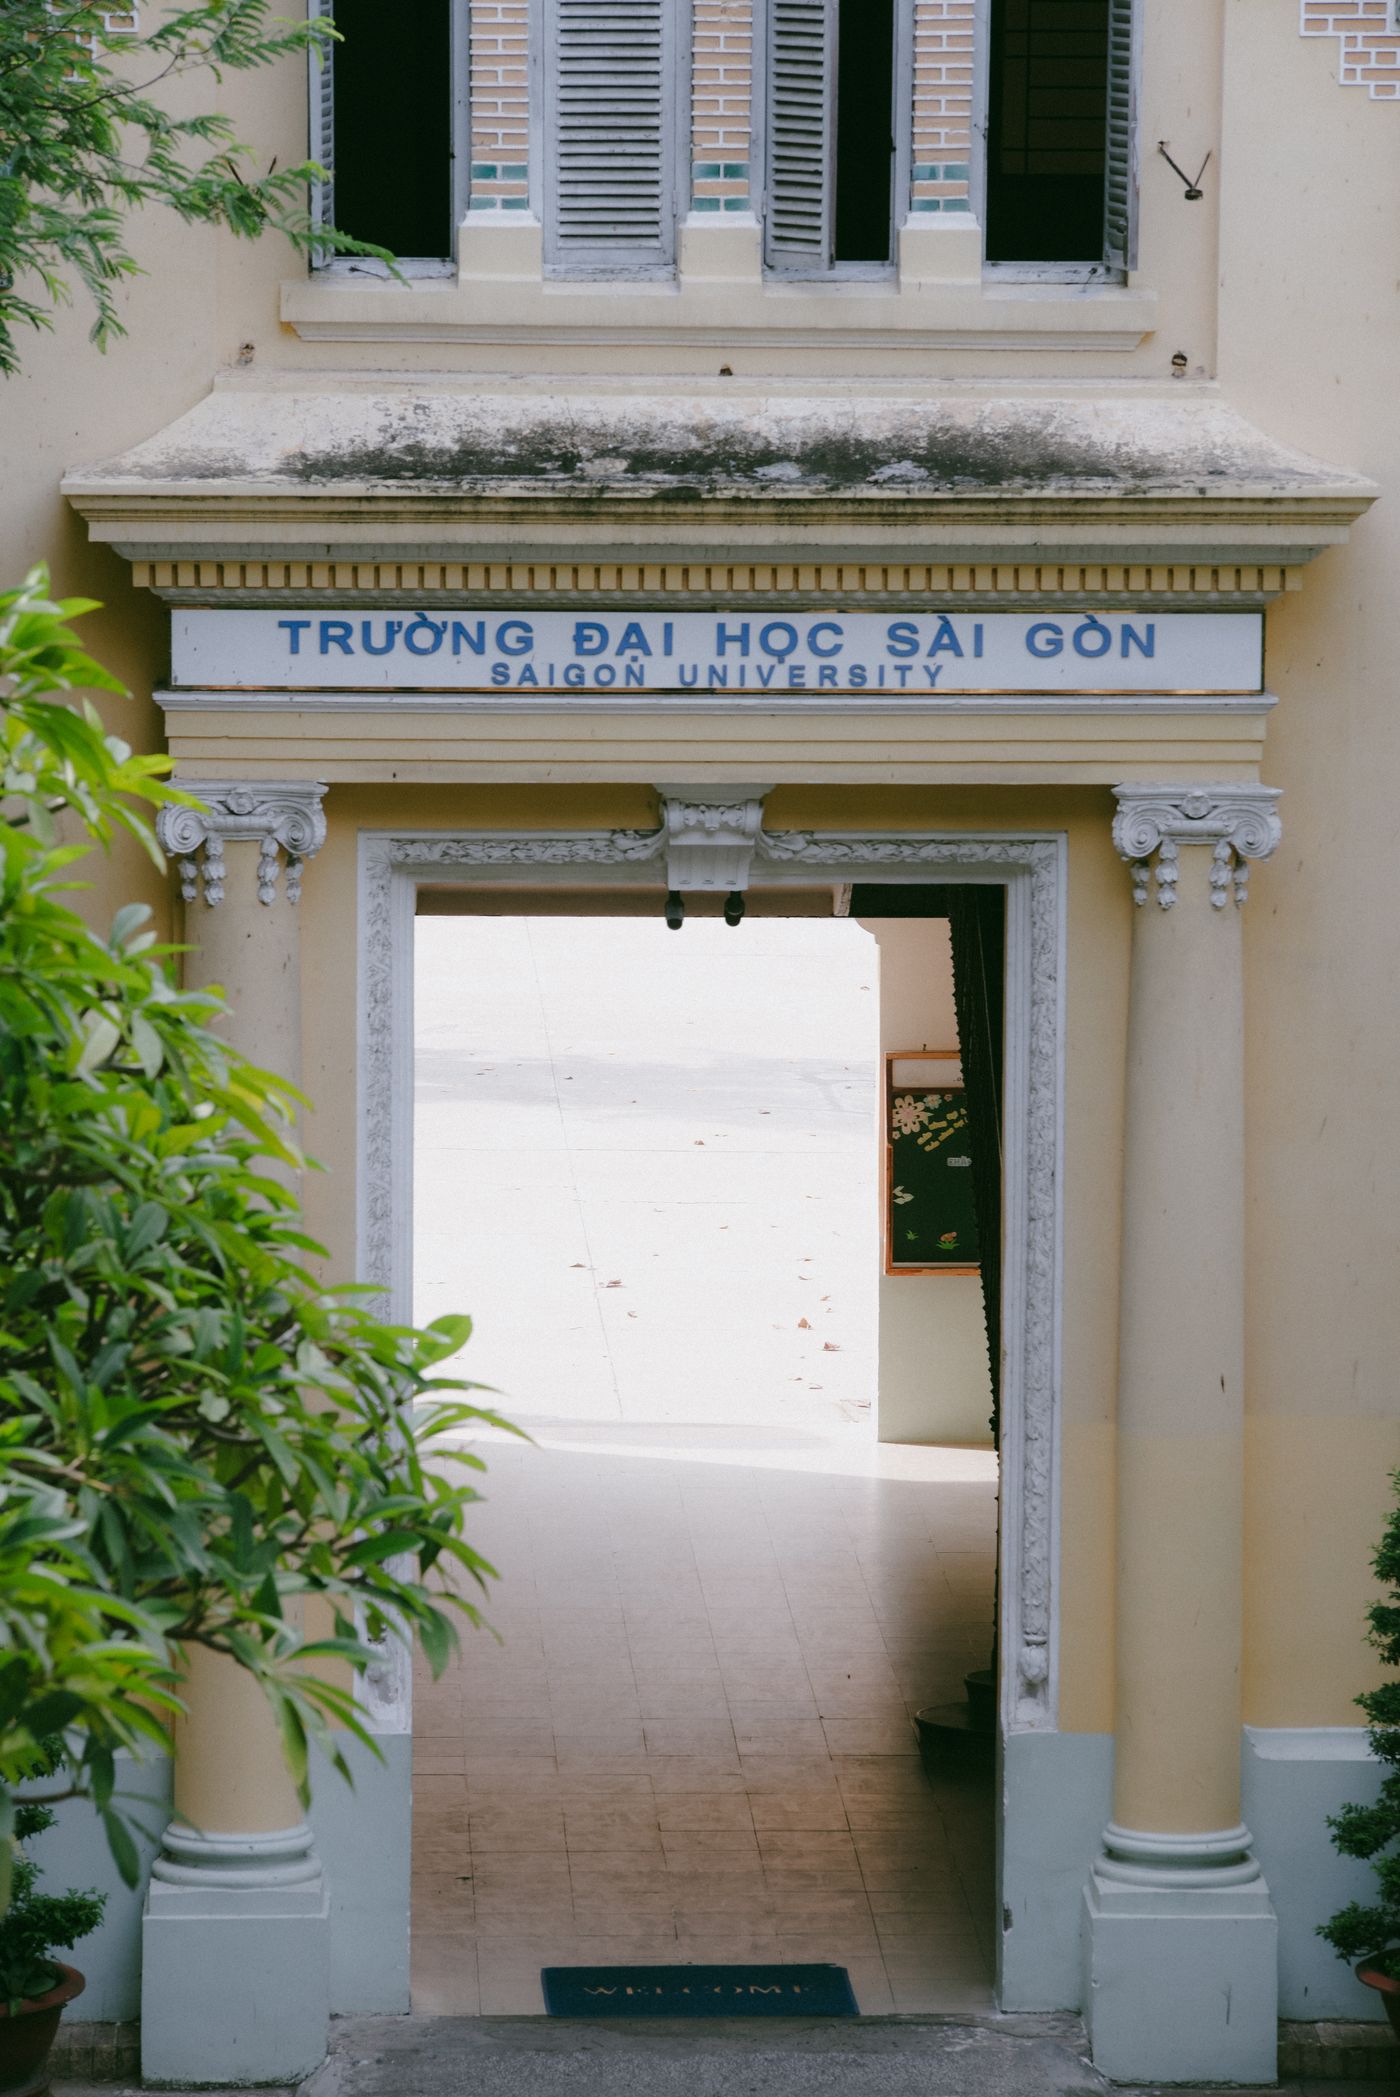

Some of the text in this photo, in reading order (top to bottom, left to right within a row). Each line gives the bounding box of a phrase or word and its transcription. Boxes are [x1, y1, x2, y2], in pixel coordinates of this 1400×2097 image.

[278, 612, 1156, 664] TRƯỜNG ĐẠI HỌC SÀI GÒN
[491, 662, 942, 687] SAIGON UNIVERSITY
